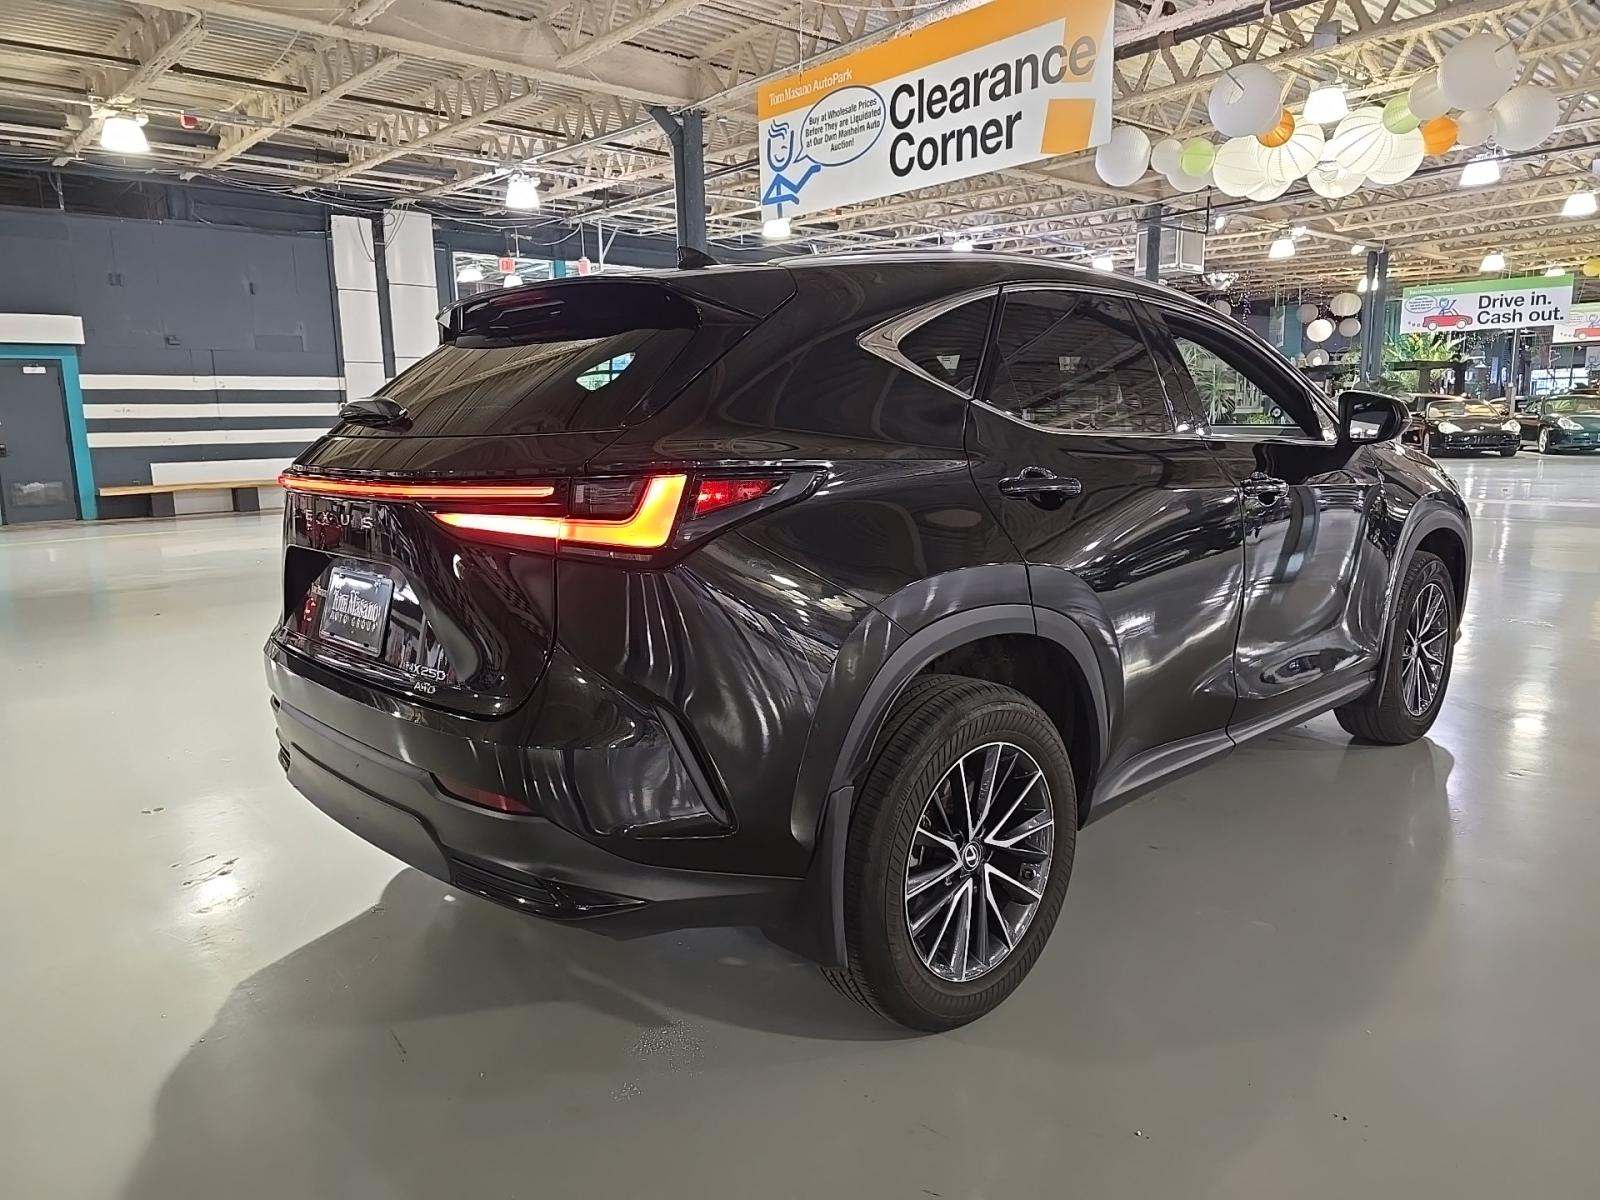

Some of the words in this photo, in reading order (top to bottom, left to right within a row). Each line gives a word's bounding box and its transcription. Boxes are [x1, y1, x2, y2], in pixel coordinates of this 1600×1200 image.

[769, 92, 785, 107] Tom
[785, 84, 812, 102] Masano
[813, 68, 854, 92] AutoPark
[890, 35, 1097, 130] Clearance
[805, 126, 823, 138] Before
[825, 121, 839, 133] They
[839, 118, 849, 127] are
[850, 106, 882, 124] Liquidated
[809, 115, 820, 126] Buy
[821, 113, 827, 122] at
[828, 104, 857, 121] Wholesale
[858, 98, 877, 110] Prices
[806, 138, 813, 148] at
[813, 136, 823, 146] Our
[824, 132, 838, 143] Own
[838, 124, 865, 139] Manheim
[866, 119, 881, 130] Auto
[830, 138, 855, 152] Auction!
[890, 110, 1023, 178] Corner
[1478, 292, 1525, 309] Drive
[1530, 291, 1552, 306] in.
[1477, 310, 1523, 325] Cash
[1528, 306, 1564, 322] out.
[294, 509, 374, 530] EXUS
